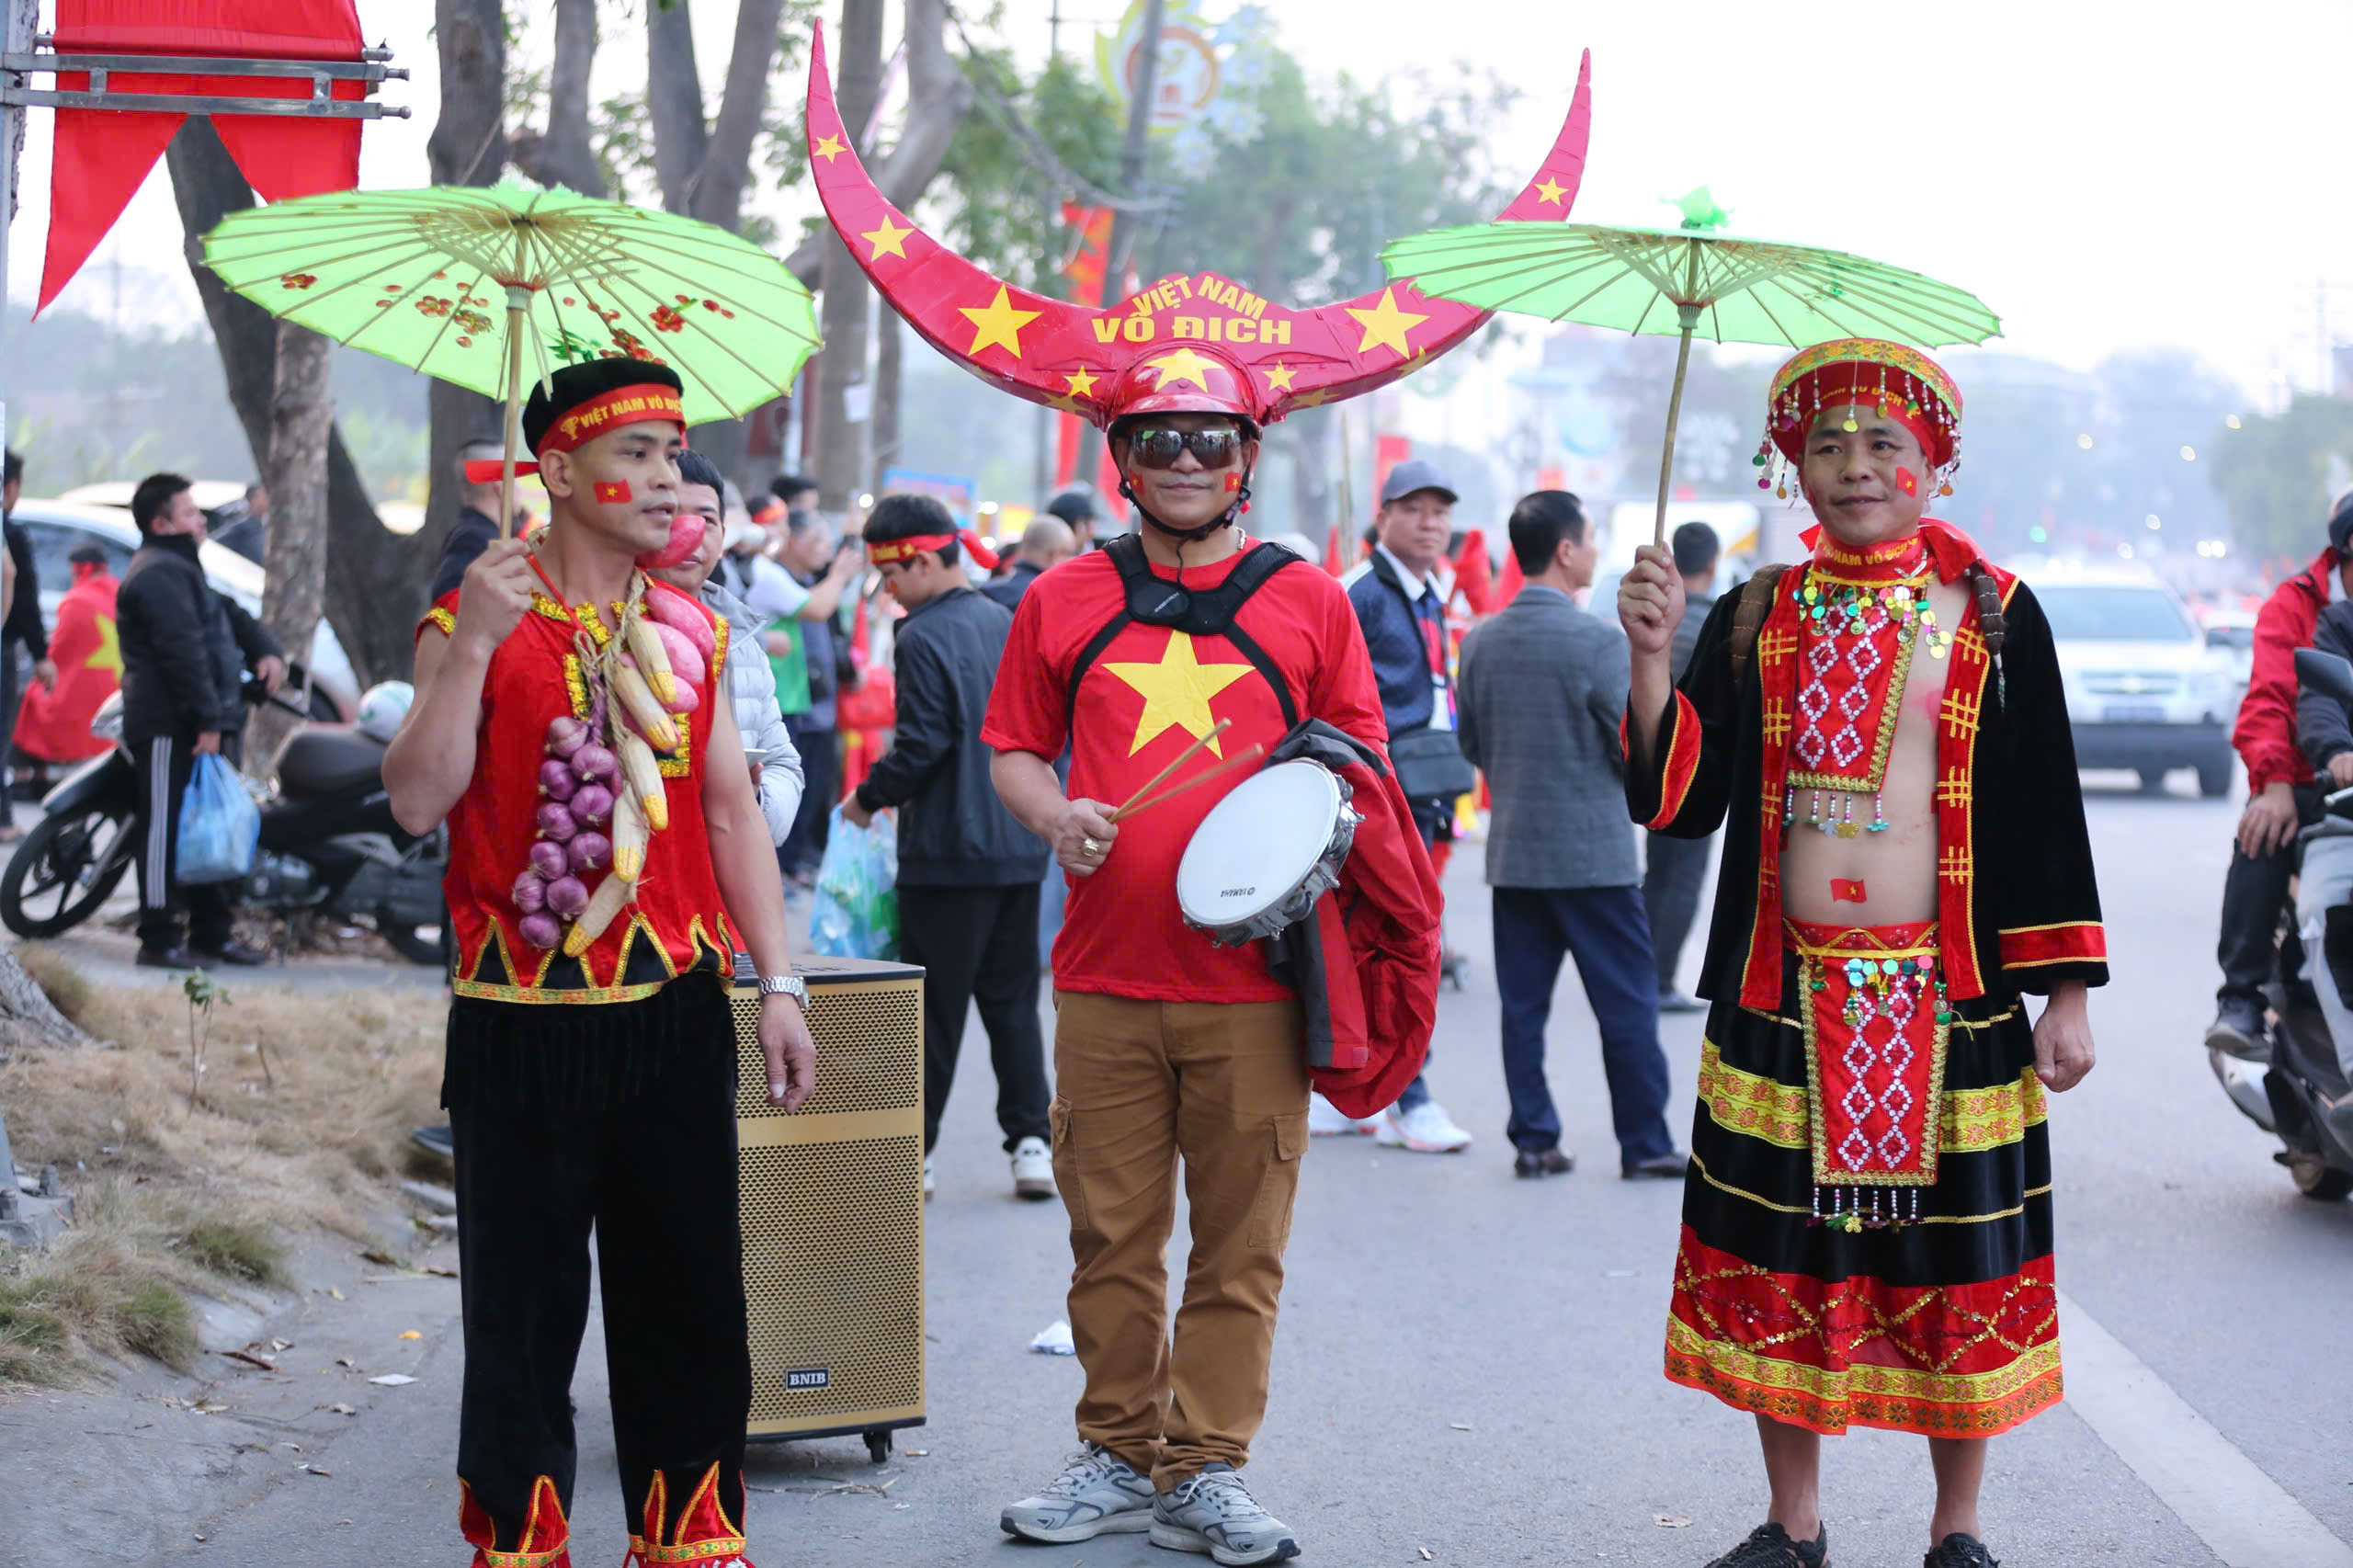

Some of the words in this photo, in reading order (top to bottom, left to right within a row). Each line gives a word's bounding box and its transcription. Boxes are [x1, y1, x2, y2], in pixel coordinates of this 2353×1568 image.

[1132, 276, 1192, 317] VIỆT
[1198, 276, 1267, 320] NAM
[580, 405, 608, 427] VIỆT
[612, 397, 645, 416] NAM
[647, 393, 664, 410] VÔ
[790, 1372, 826, 1386] BNIB
